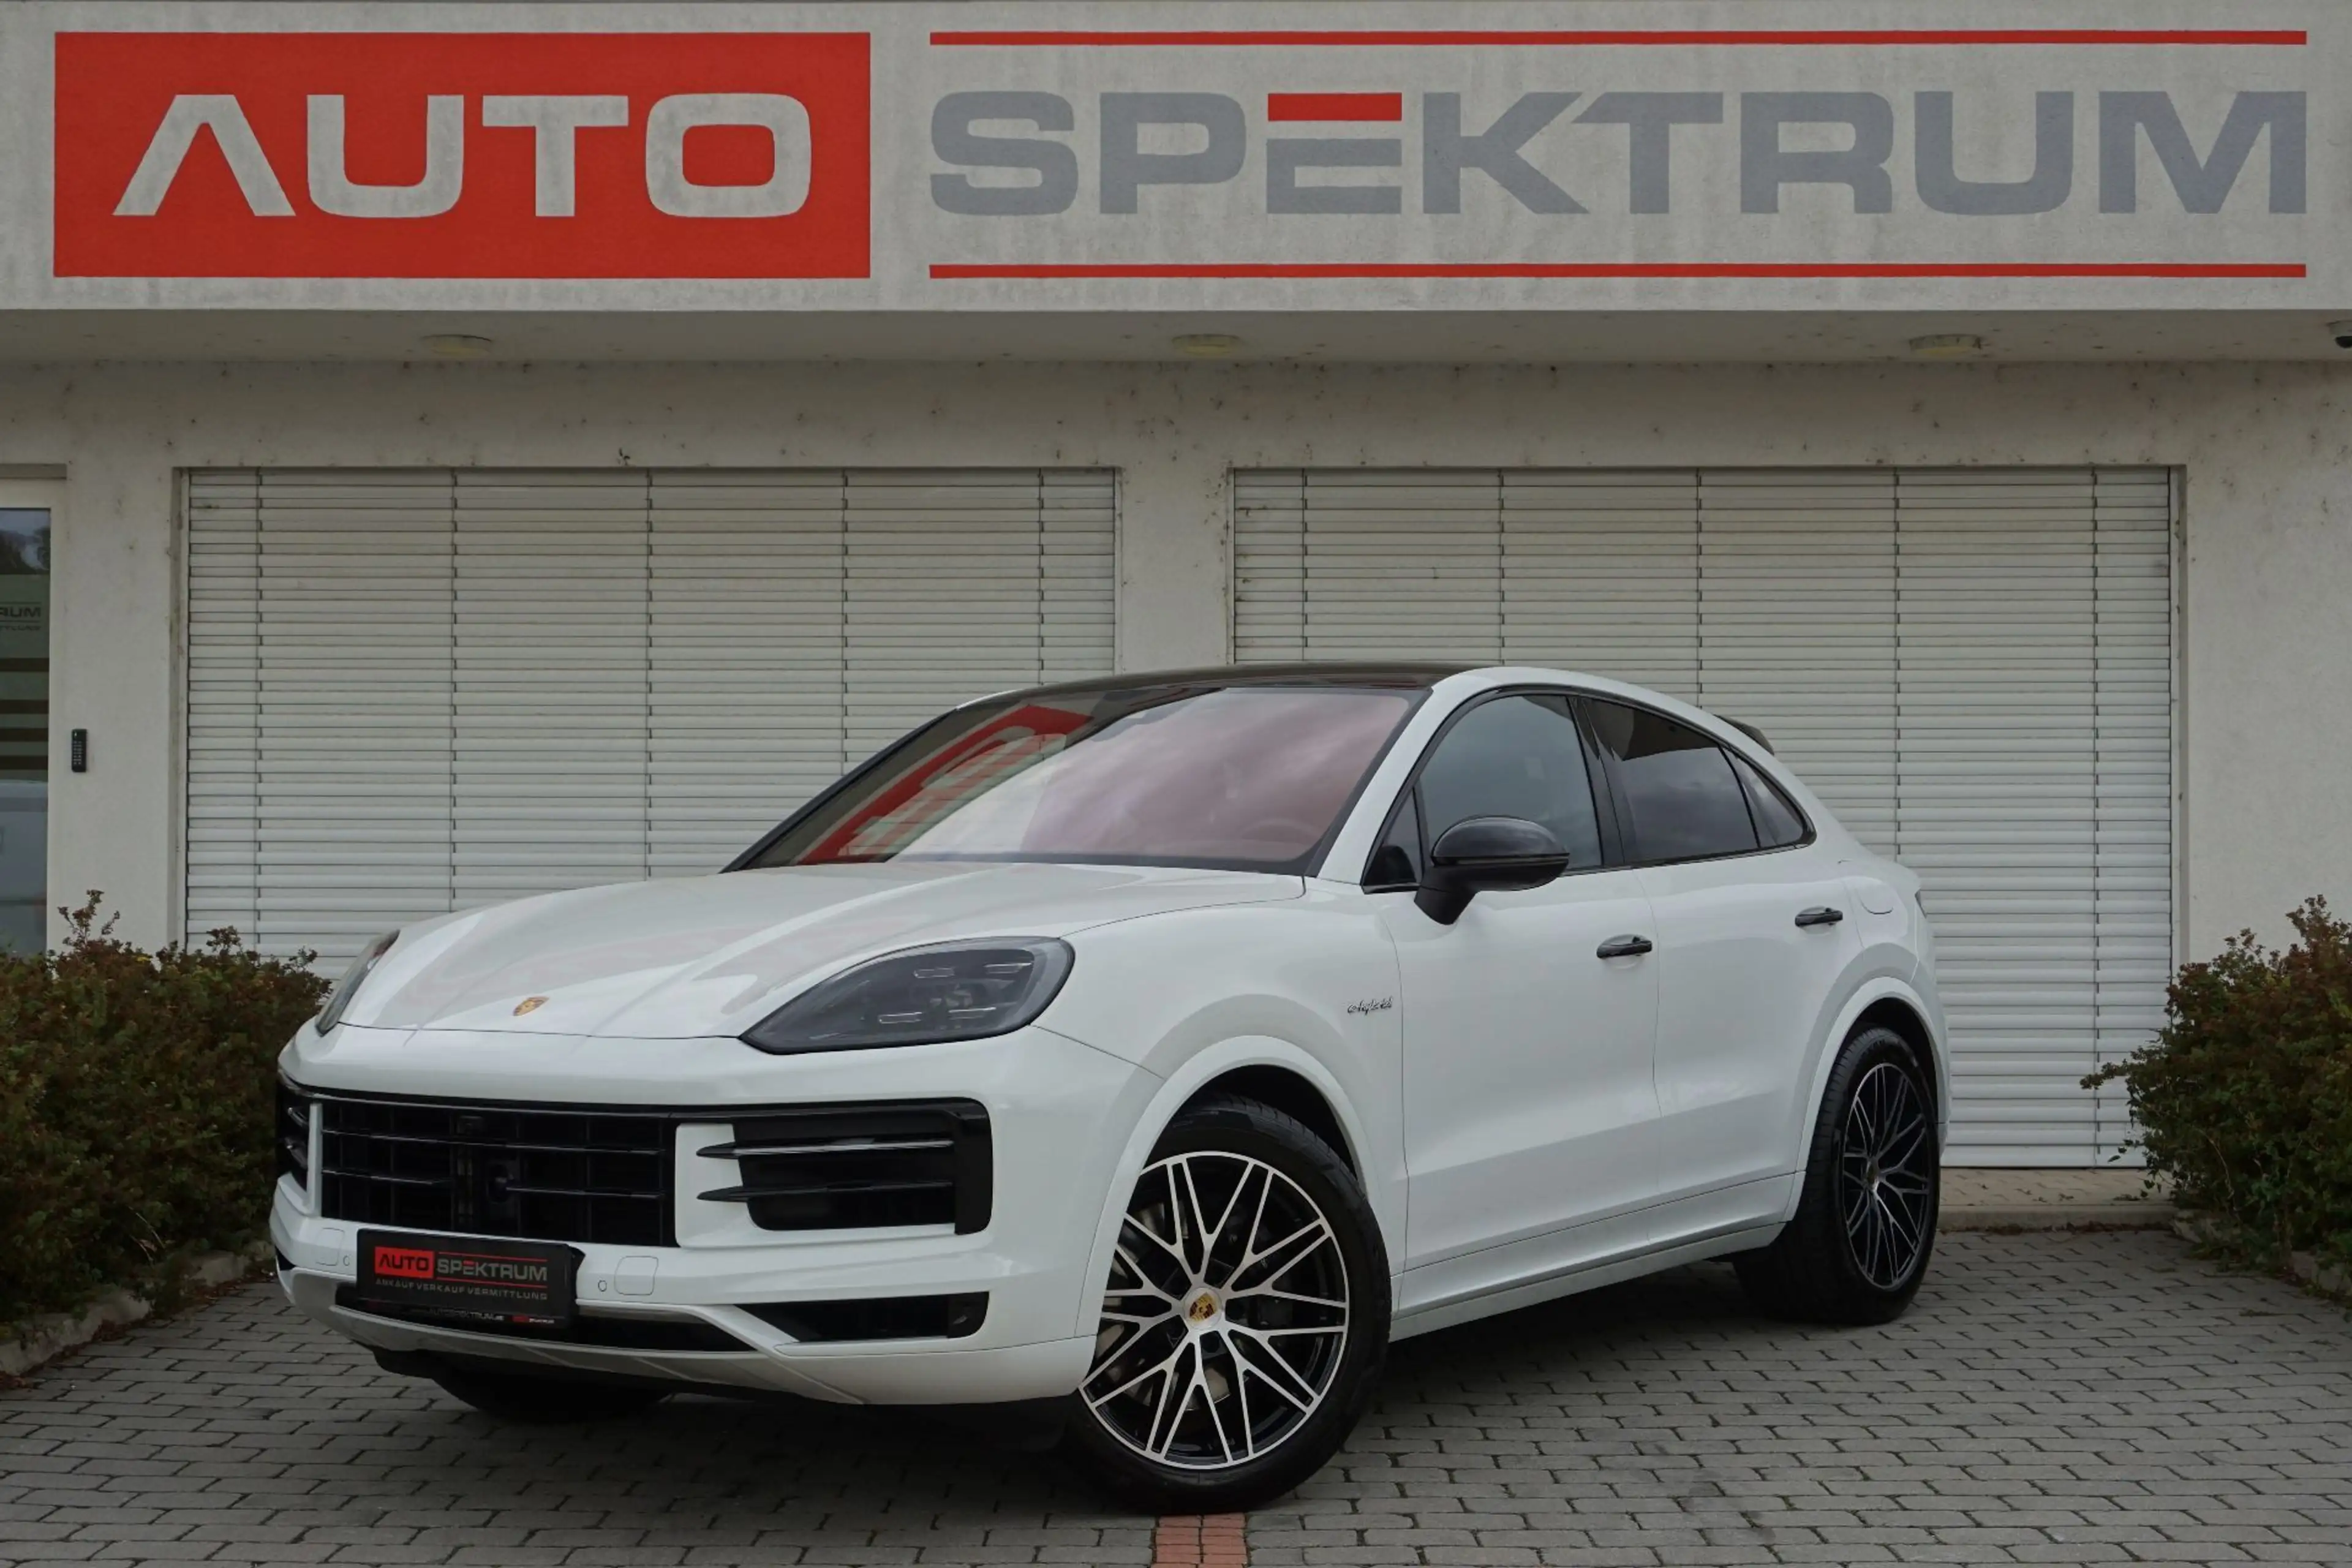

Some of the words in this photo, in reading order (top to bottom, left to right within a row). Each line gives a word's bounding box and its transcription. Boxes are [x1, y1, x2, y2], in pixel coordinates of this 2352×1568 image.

[113, 92, 812, 218] AUTO
[930, 91, 2306, 215] SPEKTRUM
[379, 1254, 429, 1272] AUTO
[437, 1258, 548, 1281] SPEKTRUM
[375, 1278, 415, 1289] ANKAUF
[417, 1281, 465, 1294] VERKAUF
[467, 1286, 548, 1300] VERMITTLUNG
